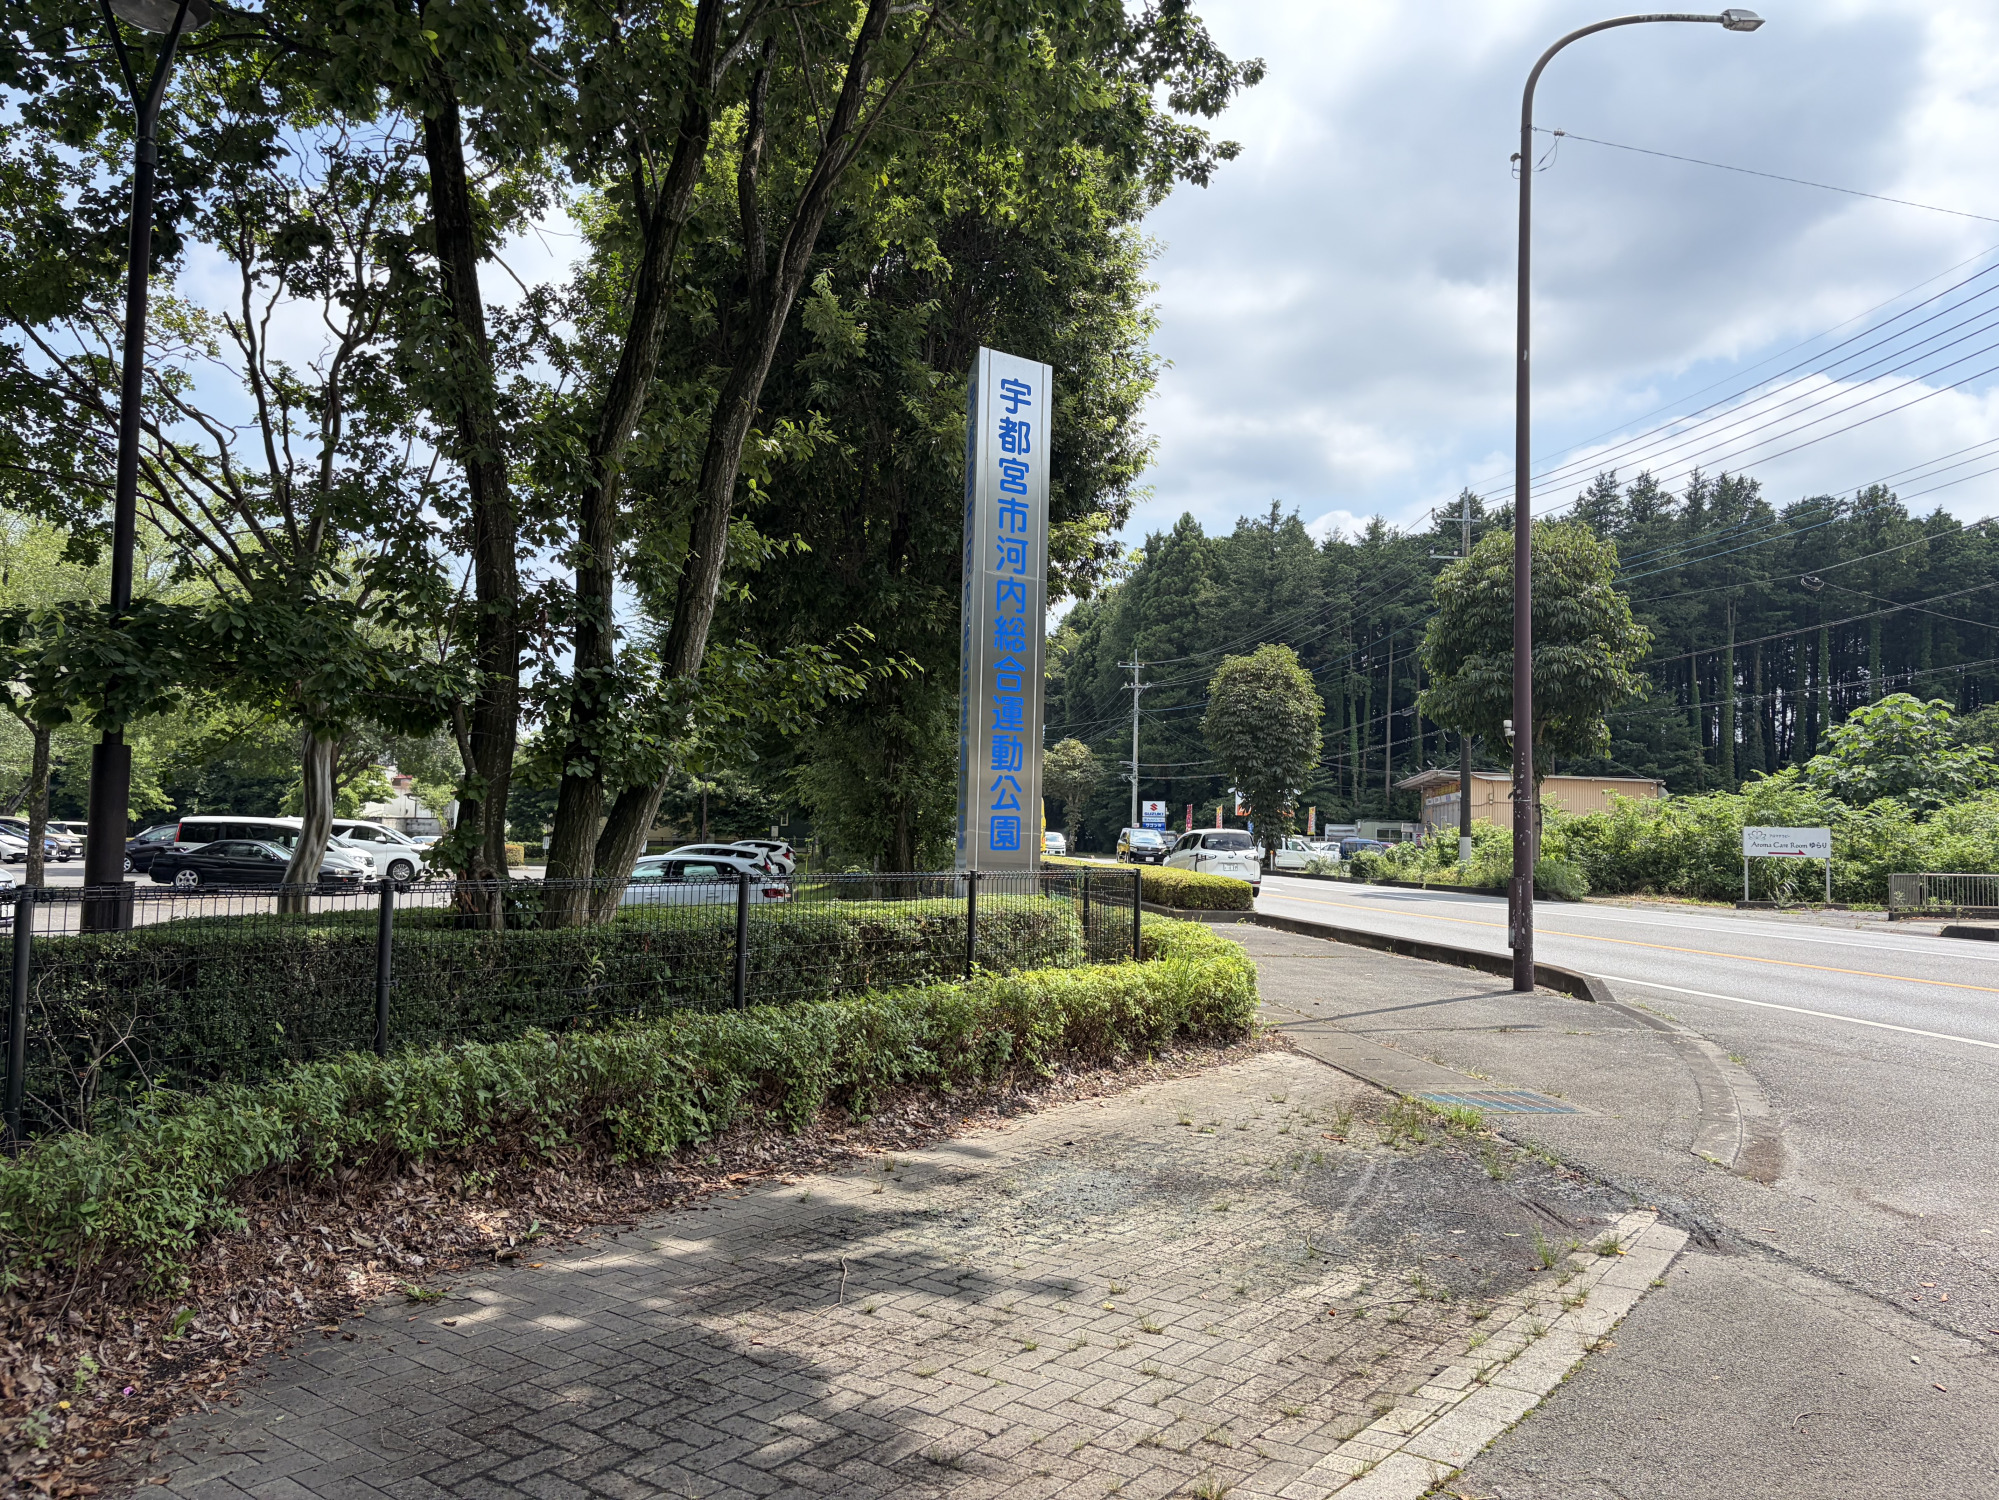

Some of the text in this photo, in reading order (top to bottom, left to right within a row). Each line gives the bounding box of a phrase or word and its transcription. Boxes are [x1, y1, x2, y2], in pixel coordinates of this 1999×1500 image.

[989, 378, 1032, 852] 宇都宮市河内総合運動公園
